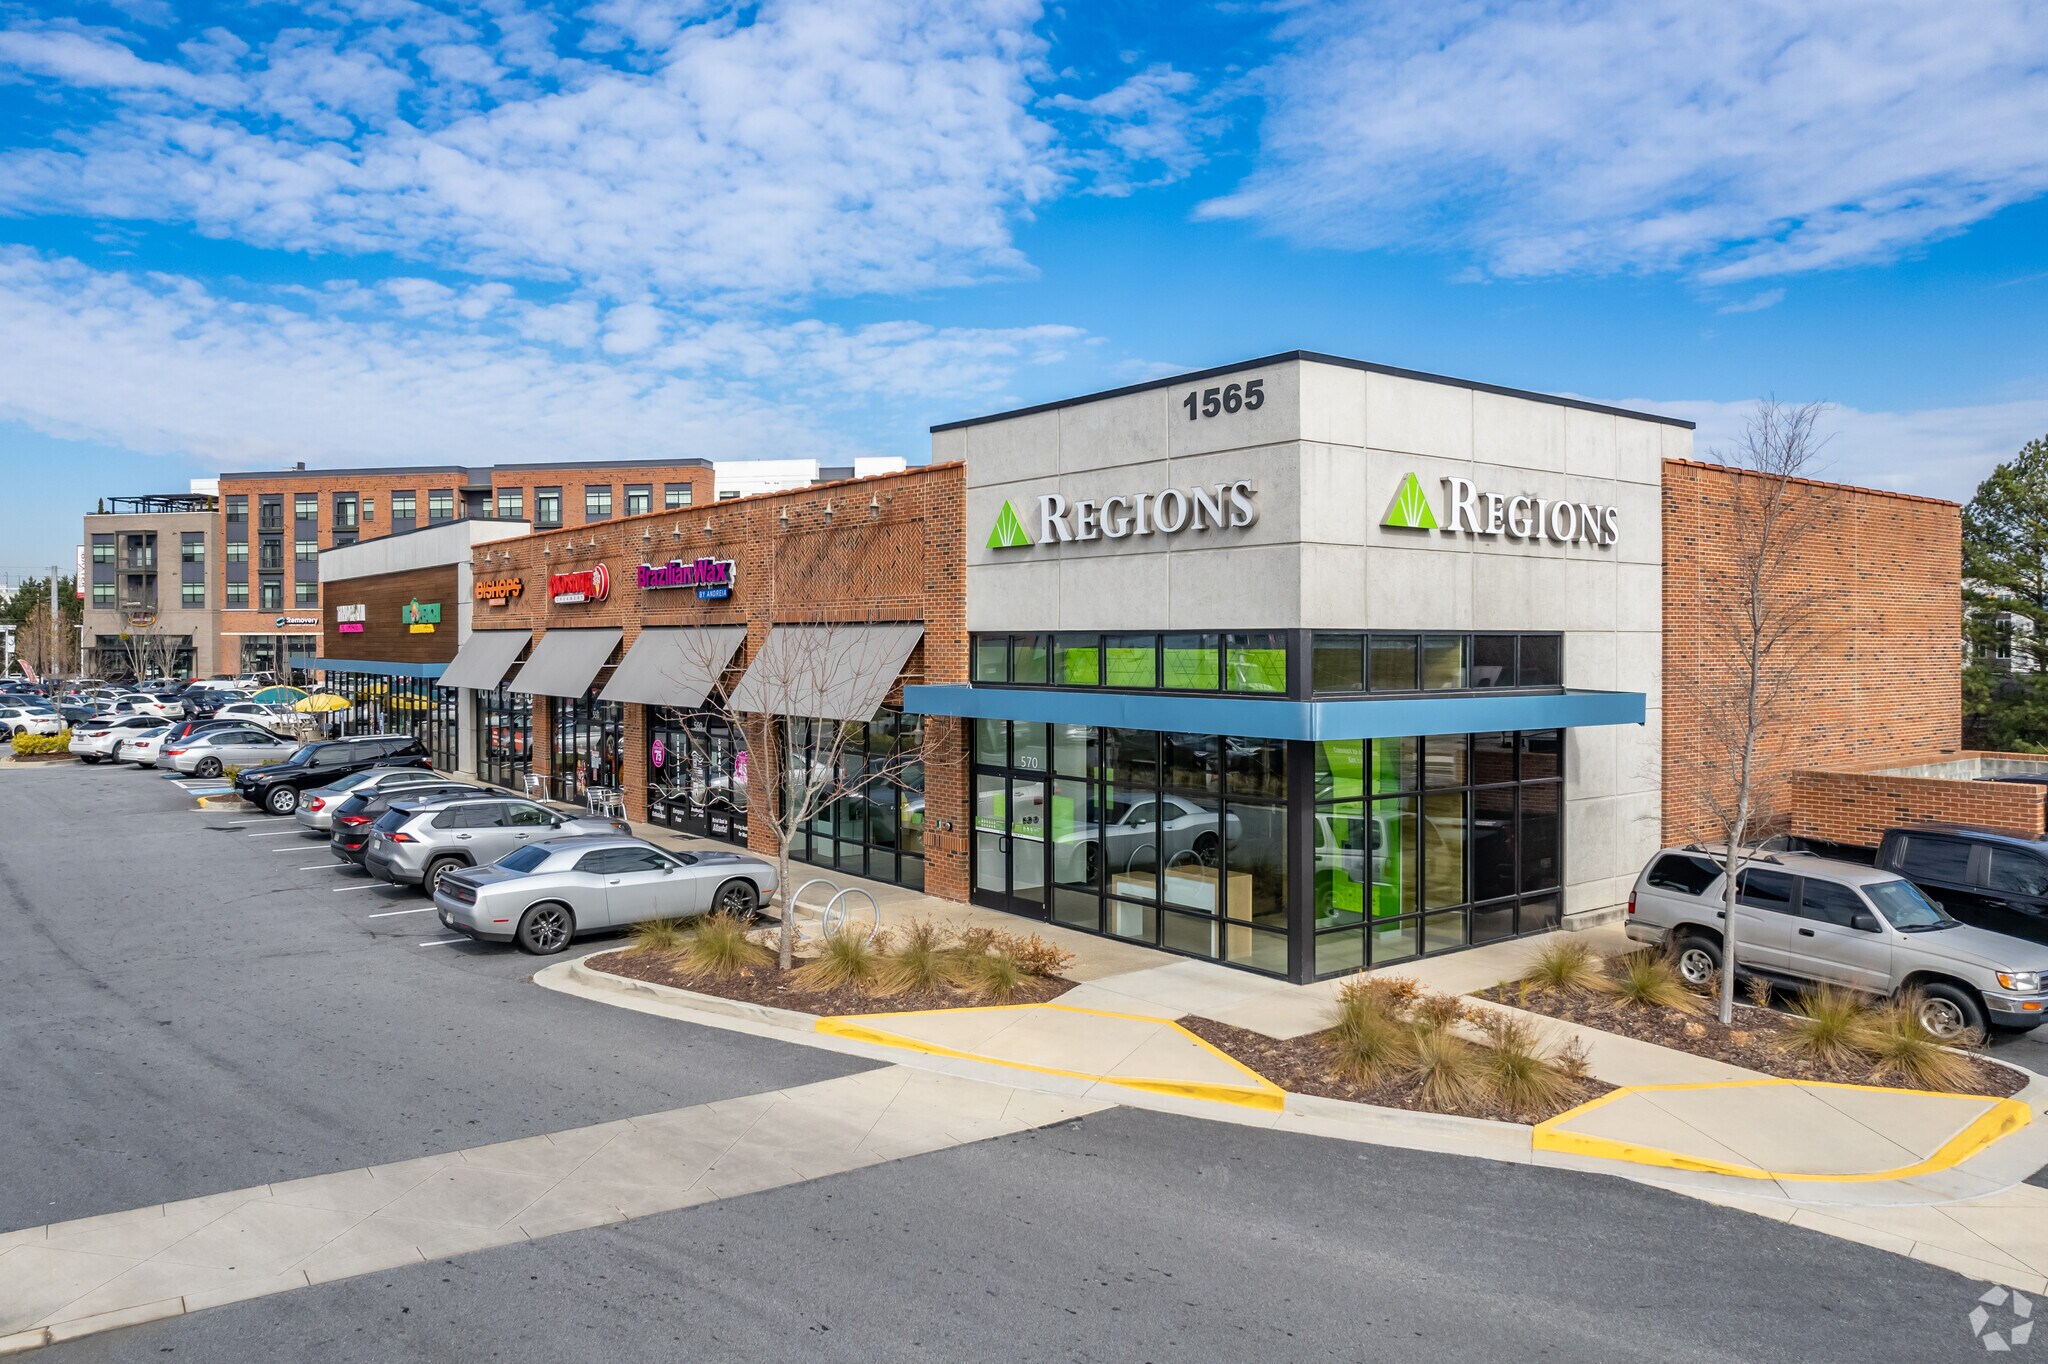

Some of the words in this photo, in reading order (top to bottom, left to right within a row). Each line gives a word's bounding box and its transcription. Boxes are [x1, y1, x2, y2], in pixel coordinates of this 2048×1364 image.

[1183, 378, 1265, 421] 1565
[1038, 479, 1257, 544] REGIONS
[1442, 476, 1620, 545] REGIONS
[475, 578, 521, 599] BISHOPS
[637, 561, 692, 589] Brazilian
[693, 559, 728, 583] Wax
[1021, 756, 1038, 769] 570
